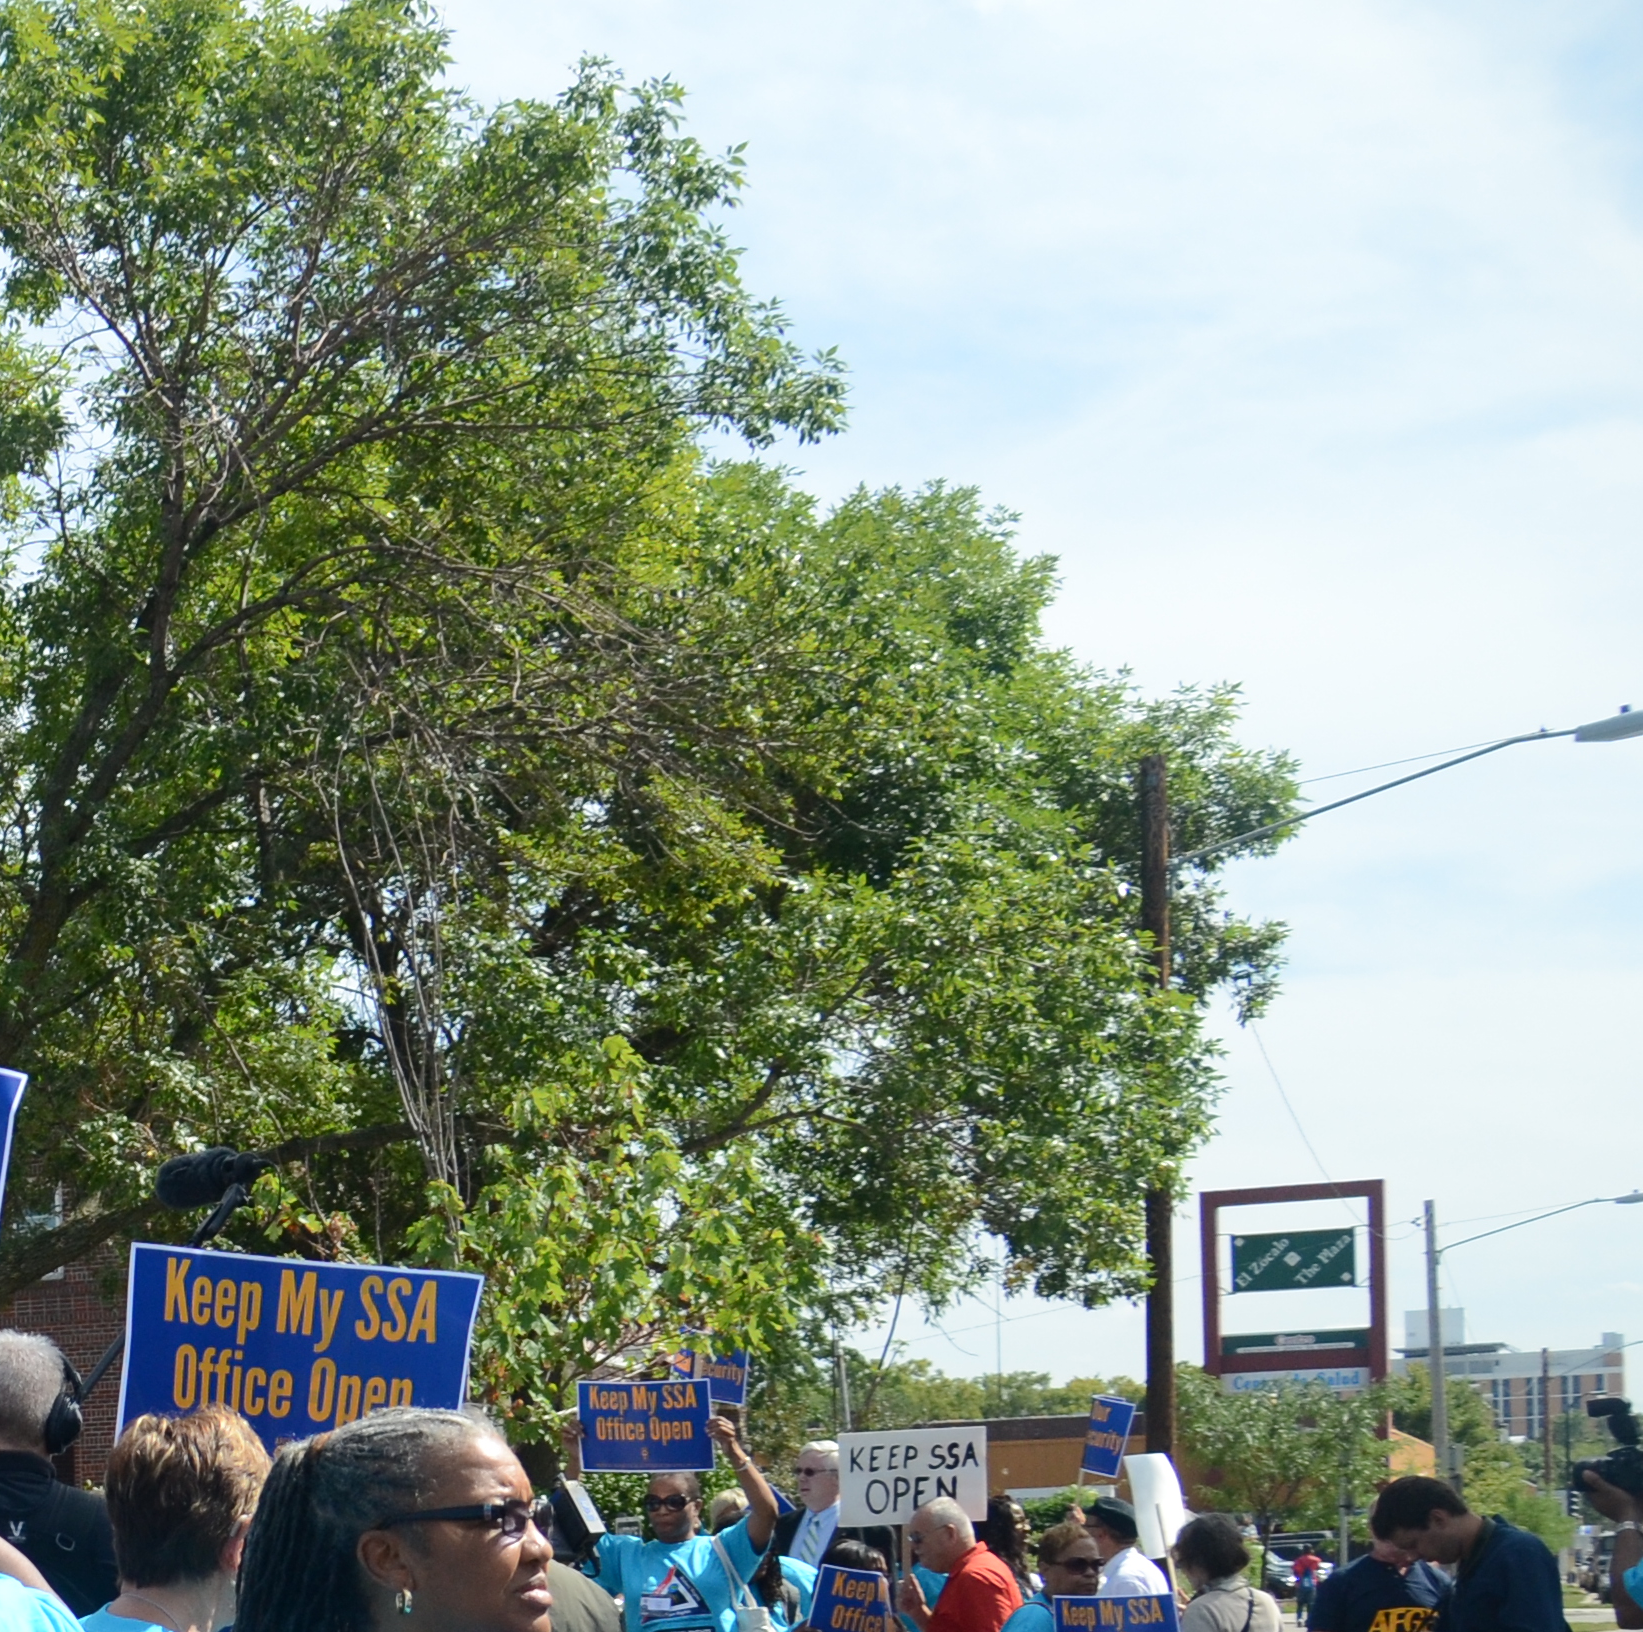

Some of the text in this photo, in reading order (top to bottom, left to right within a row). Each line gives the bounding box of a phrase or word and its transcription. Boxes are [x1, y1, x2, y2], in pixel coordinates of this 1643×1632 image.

[1293, 1234, 1352, 1285] The Plaza
[1234, 1272, 1252, 1288] El
[163, 1256, 438, 1352] Keep My SSA
[173, 1343, 414, 1430] Office Open
[588, 1383, 698, 1416] Keep My SSA
[595, 1416, 694, 1446] Office Open
[849, 1441, 980, 1473] KEEP SSA
[865, 1475, 958, 1515] OPEN
[830, 1571, 876, 1606] Keep
[1061, 1597, 1164, 1631] Keep My SSA
